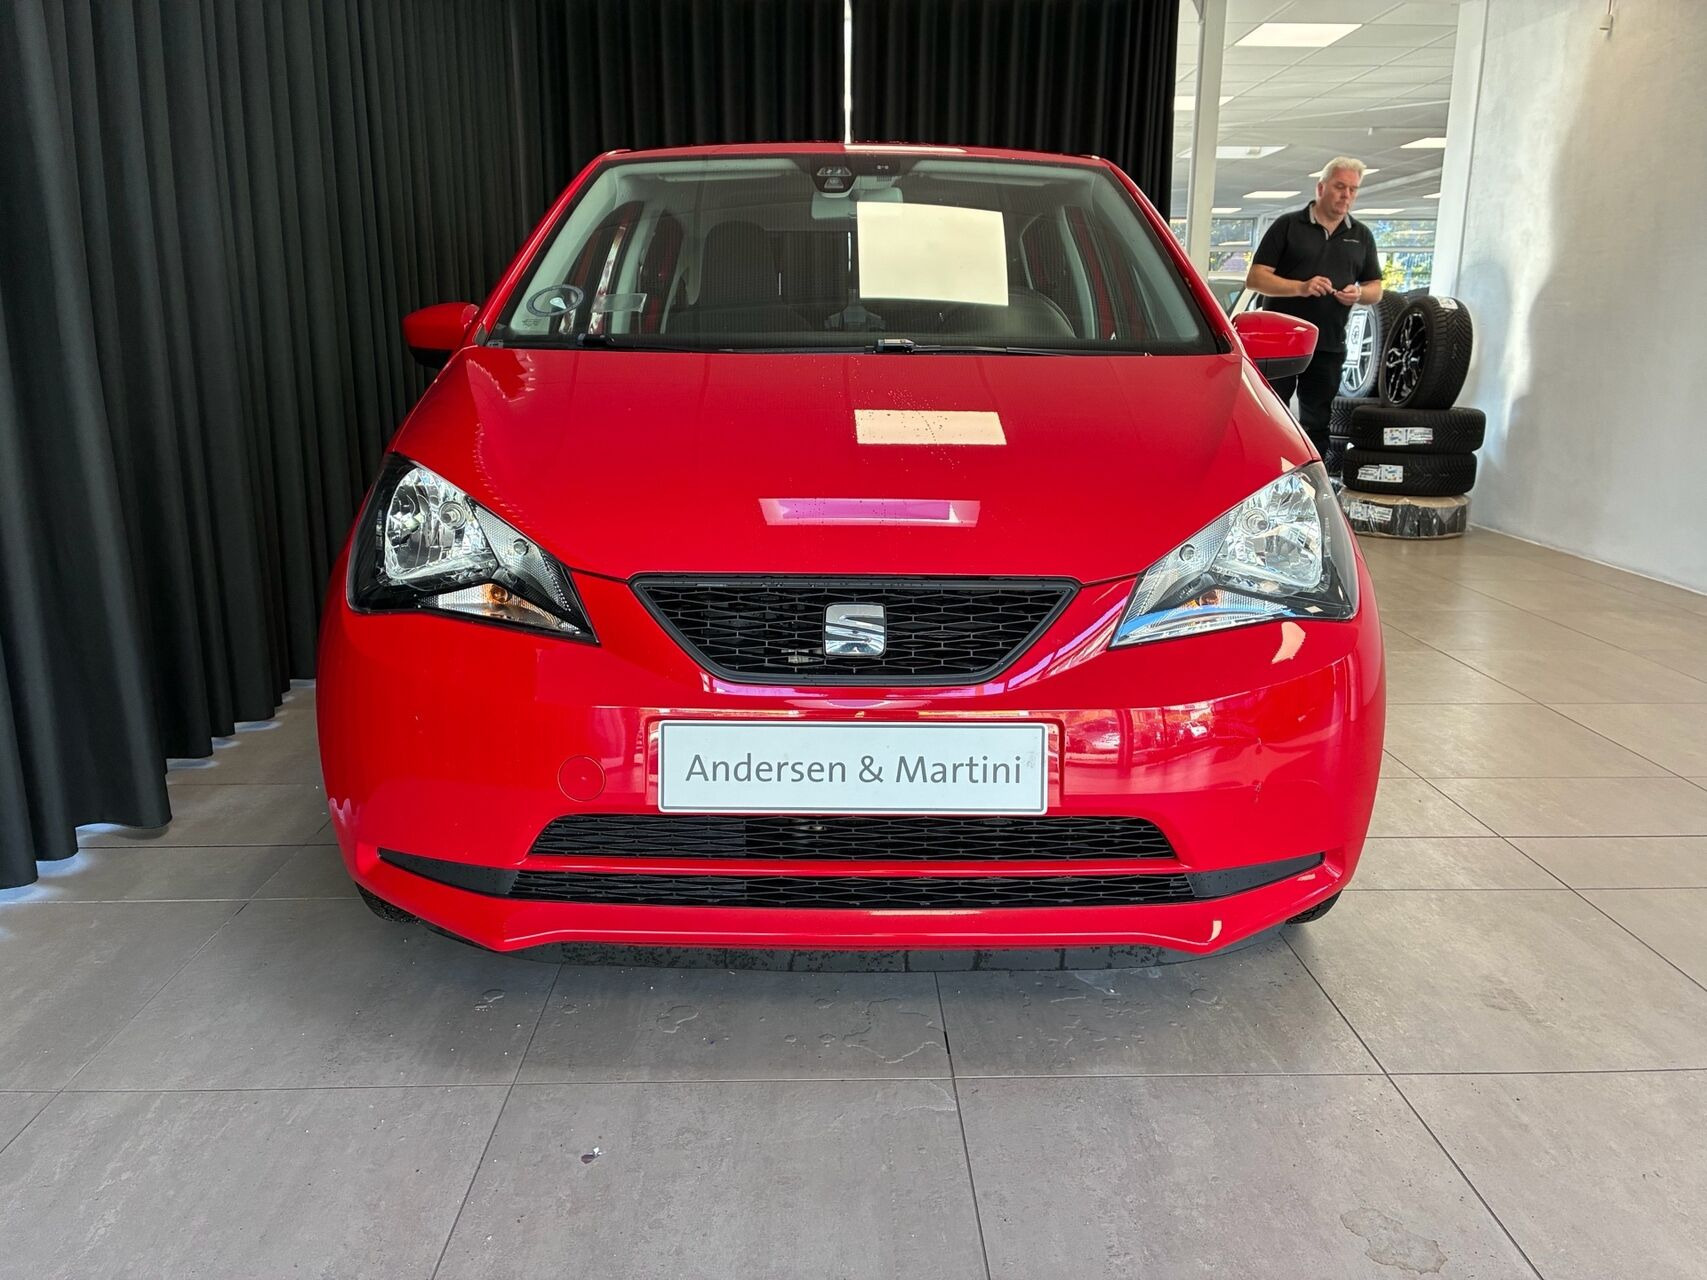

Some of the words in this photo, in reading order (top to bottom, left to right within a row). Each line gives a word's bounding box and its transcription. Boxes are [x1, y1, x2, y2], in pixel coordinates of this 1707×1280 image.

[685, 752, 846, 783] Andersen
[858, 755, 884, 784] &
[895, 754, 1022, 784] Martini
